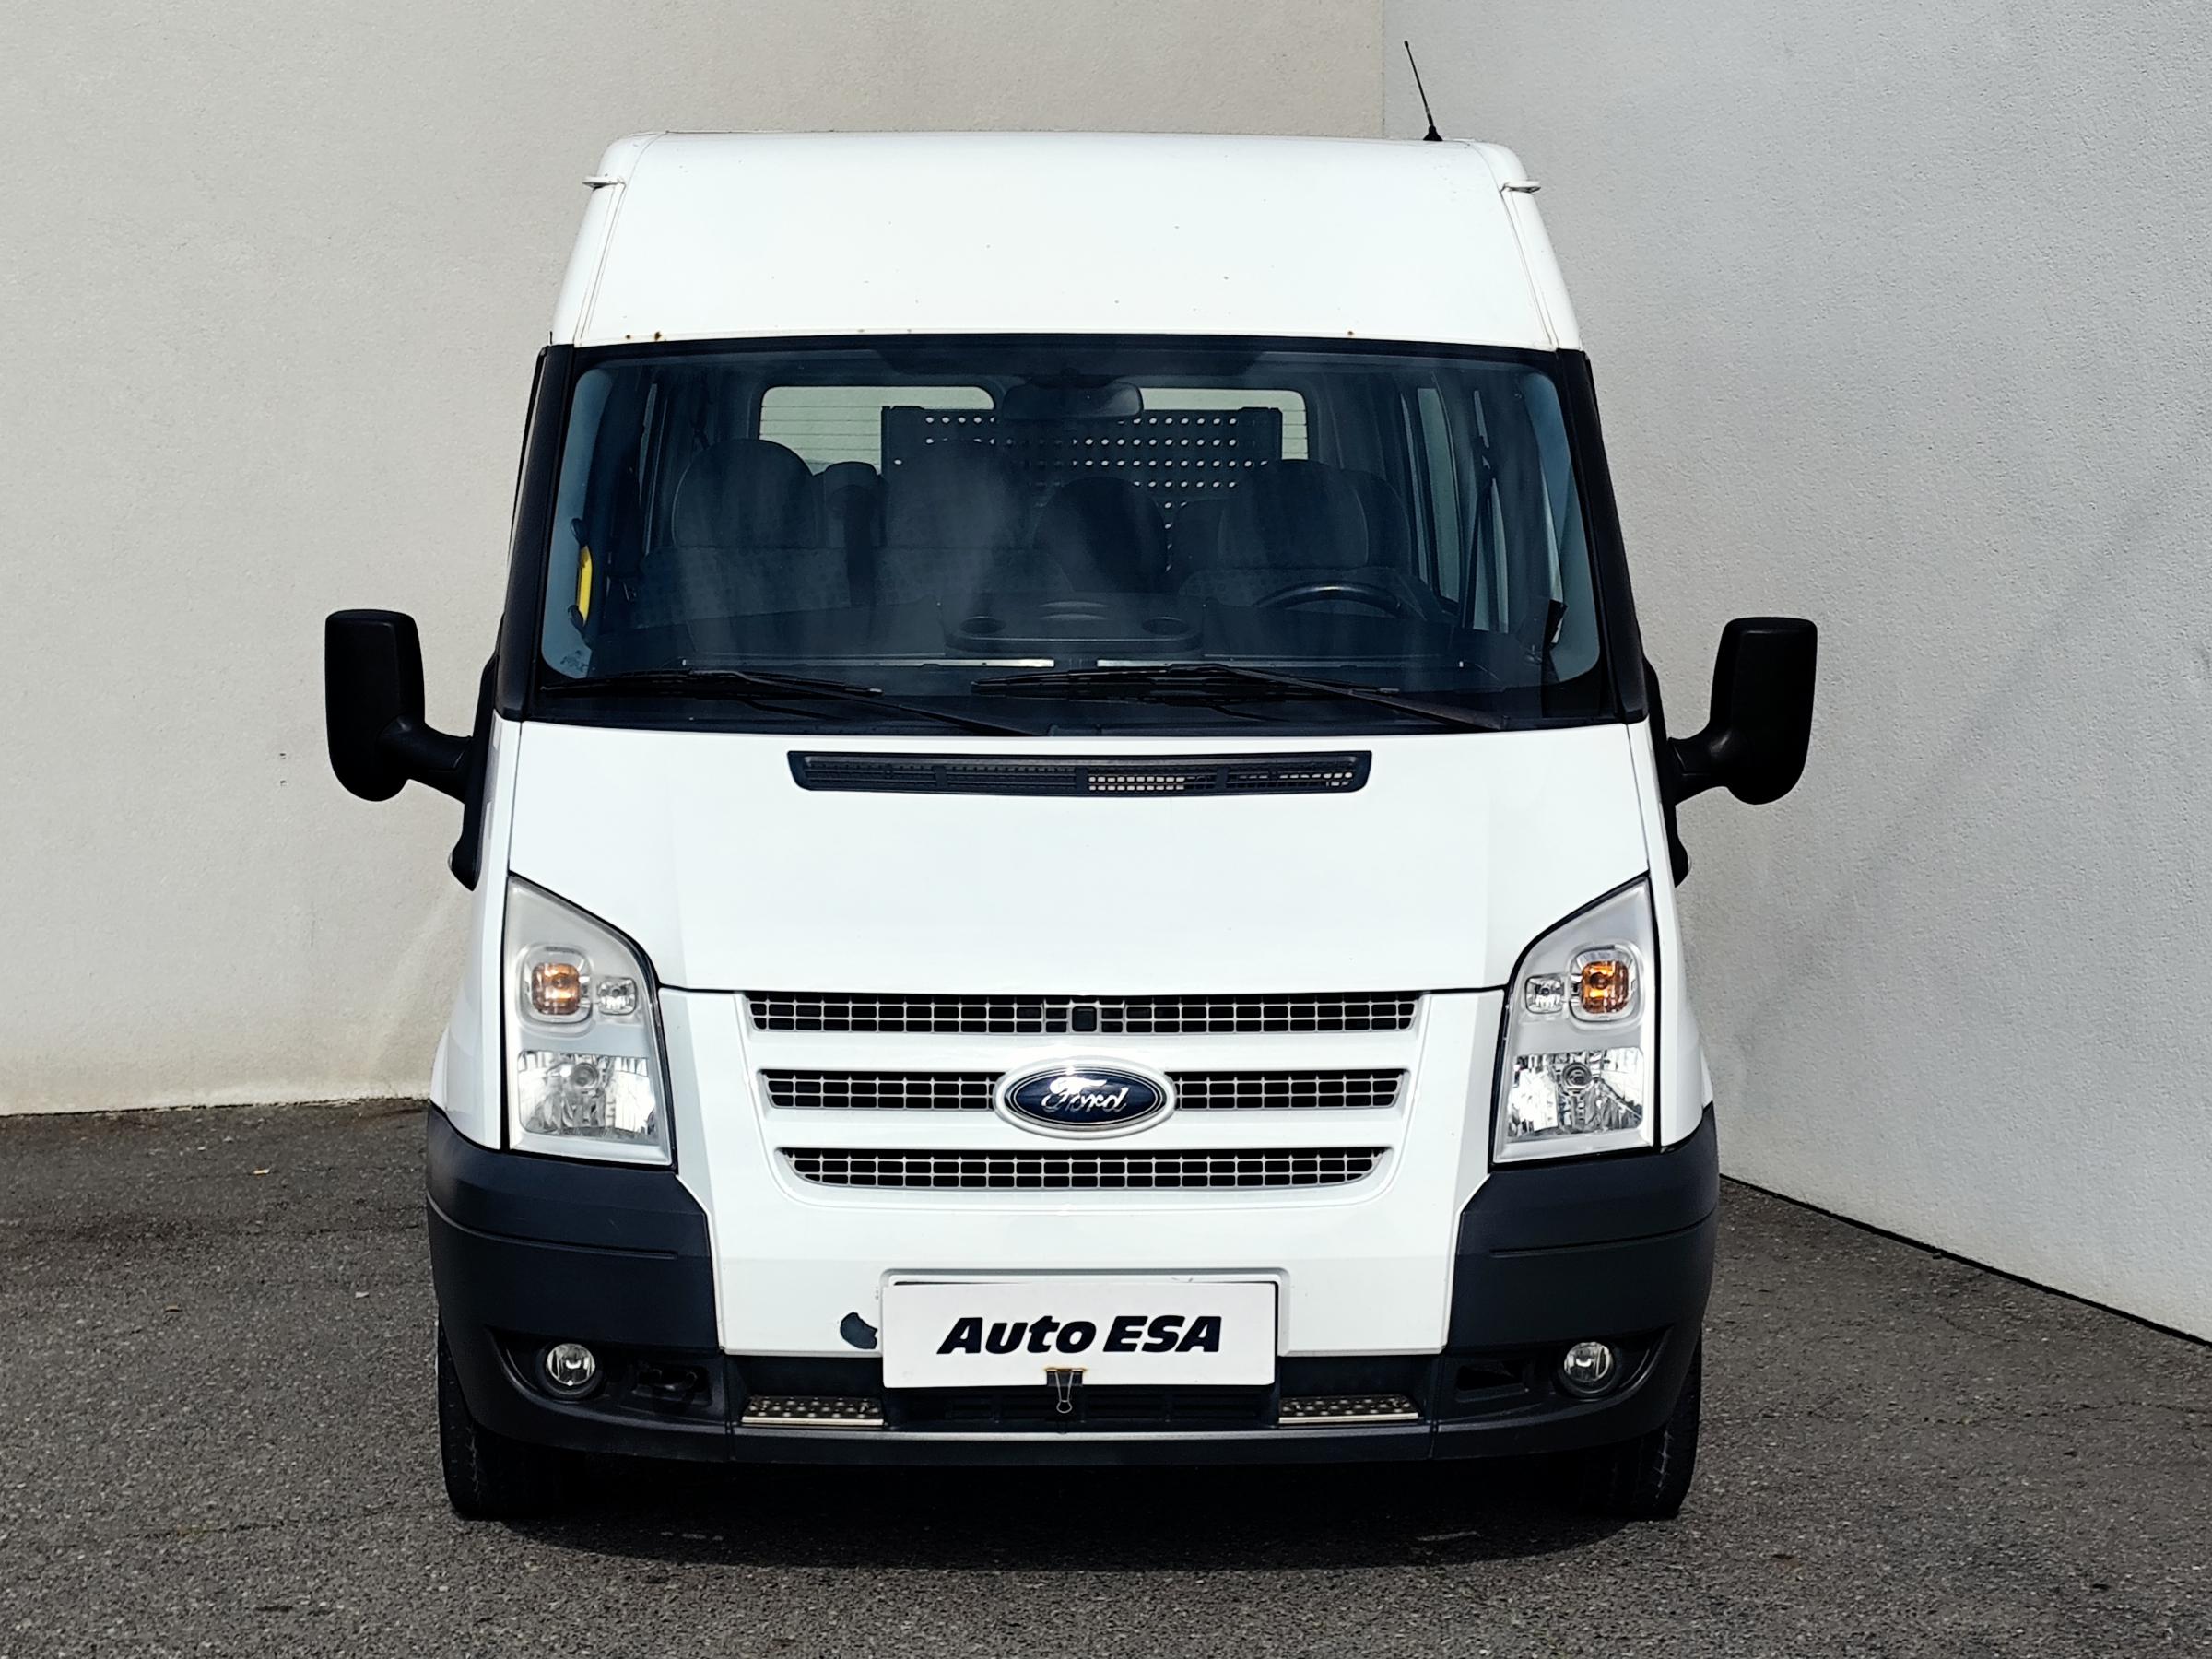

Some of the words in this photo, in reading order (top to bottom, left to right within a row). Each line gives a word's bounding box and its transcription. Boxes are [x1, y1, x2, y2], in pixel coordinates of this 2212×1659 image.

[1041, 1076, 1129, 1113] Ford
[936, 1315, 1097, 1355] Auto
[1102, 1314, 1222, 1353] ESA
